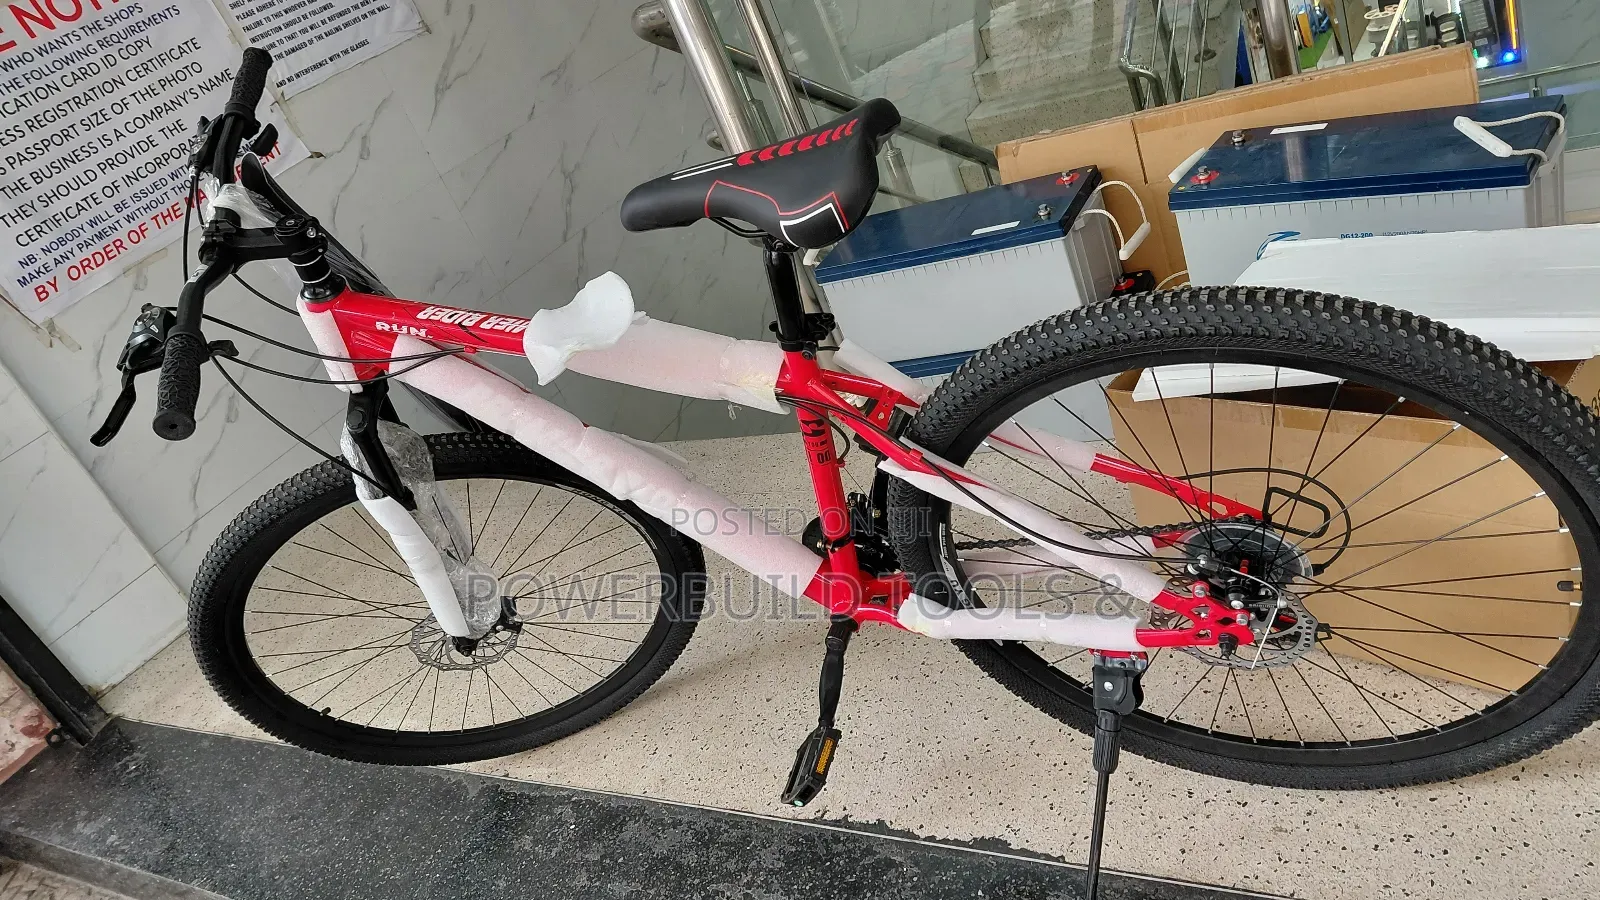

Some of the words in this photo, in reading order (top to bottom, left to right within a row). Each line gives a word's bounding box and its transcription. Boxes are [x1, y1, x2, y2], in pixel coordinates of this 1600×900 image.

[33, 30, 81, 57] WANTS
[79, 20, 105, 36] THE
[104, 3, 143, 26] SHOPS
[235, 9, 256, 21] PLEASE
[255, 0, 276, 13] ADHERE
[242, 19, 264, 33] FAILURE
[271, 11, 284, 20] THIS
[283, 1, 307, 15] WHOEVER
[249, 25, 283, 44] INSTRUCTION
[282, 17, 302, 29] SHOULD
[273, 52, 285, 61] THE
[284, 41, 308, 56] DAMAGED
[307, 38, 315, 46] OF
[313, 33, 325, 42] THE
[324, 25, 343, 38] NAILING
[341, 16, 361, 29] SHELVES
[361, 12, 369, 20] ON
[367, 8, 377, 17] THE
[276, 38, 284, 46] TO
[298, 27, 309, 36] YOU
[308, 21, 321, 31] WILL
[327, 8, 351, 22] REFUNDED
[350, 3, 360, 11] THE
[22, 43, 98, 84] FOLLOWING
[96, 5, 180, 50] REQUIREMENTS
[60, 62, 100, 87] CARD
[100, 54, 117, 69] ID
[118, 36, 152, 60] COPY
[275, 79, 287, 88] AND
[286, 75, 294, 83] NO
[294, 59, 329, 79] INTERFERENCE
[328, 52, 341, 62] WITH
[340, 48, 350, 57] THE
[24, 75, 126, 132] REGISTRATION
[125, 37, 201, 81] CERTIFICATE
[0, 177, 32, 199] THE
[29, 141, 99, 185] BUSINESS
[97, 134, 113, 148] IS
[113, 128, 127, 142] A
[124, 87, 199, 133] COMPANY'S
[197, 68, 234, 95] NAME
[5, 123, 80, 169] PASSPORT
[80, 108, 112, 131] SIZE
[110, 97, 130, 115] OF
[129, 84, 160, 104] THE
[158, 62, 202, 91] PHOTO
[0, 200, 38, 228] THEY
[37, 169, 97, 208] SHOULD
[96, 134, 159, 175] PROVIDE
[158, 118, 188, 140] THE
[15, 192, 102, 247] CERTIFICATE
[101, 180, 121, 198] OF
[17, 262, 53, 288] MAKE
[53, 247, 76, 267] ANY
[76, 219, 123, 253] PAYMENT
[123, 191, 171, 224] WITHOUT
[18, 253, 42, 269] NB:
[40, 224, 87, 256] NOBODY
[85, 210, 115, 228] WILL
[113, 199, 131, 213] BE
[129, 177, 168, 204] ISSUED
[34, 276, 58, 302] BY
[67, 238, 128, 281] ORDER
[127, 222, 149, 244] OF
[150, 202, 184, 229] THE
[416, 305, 481, 326] RIDER
